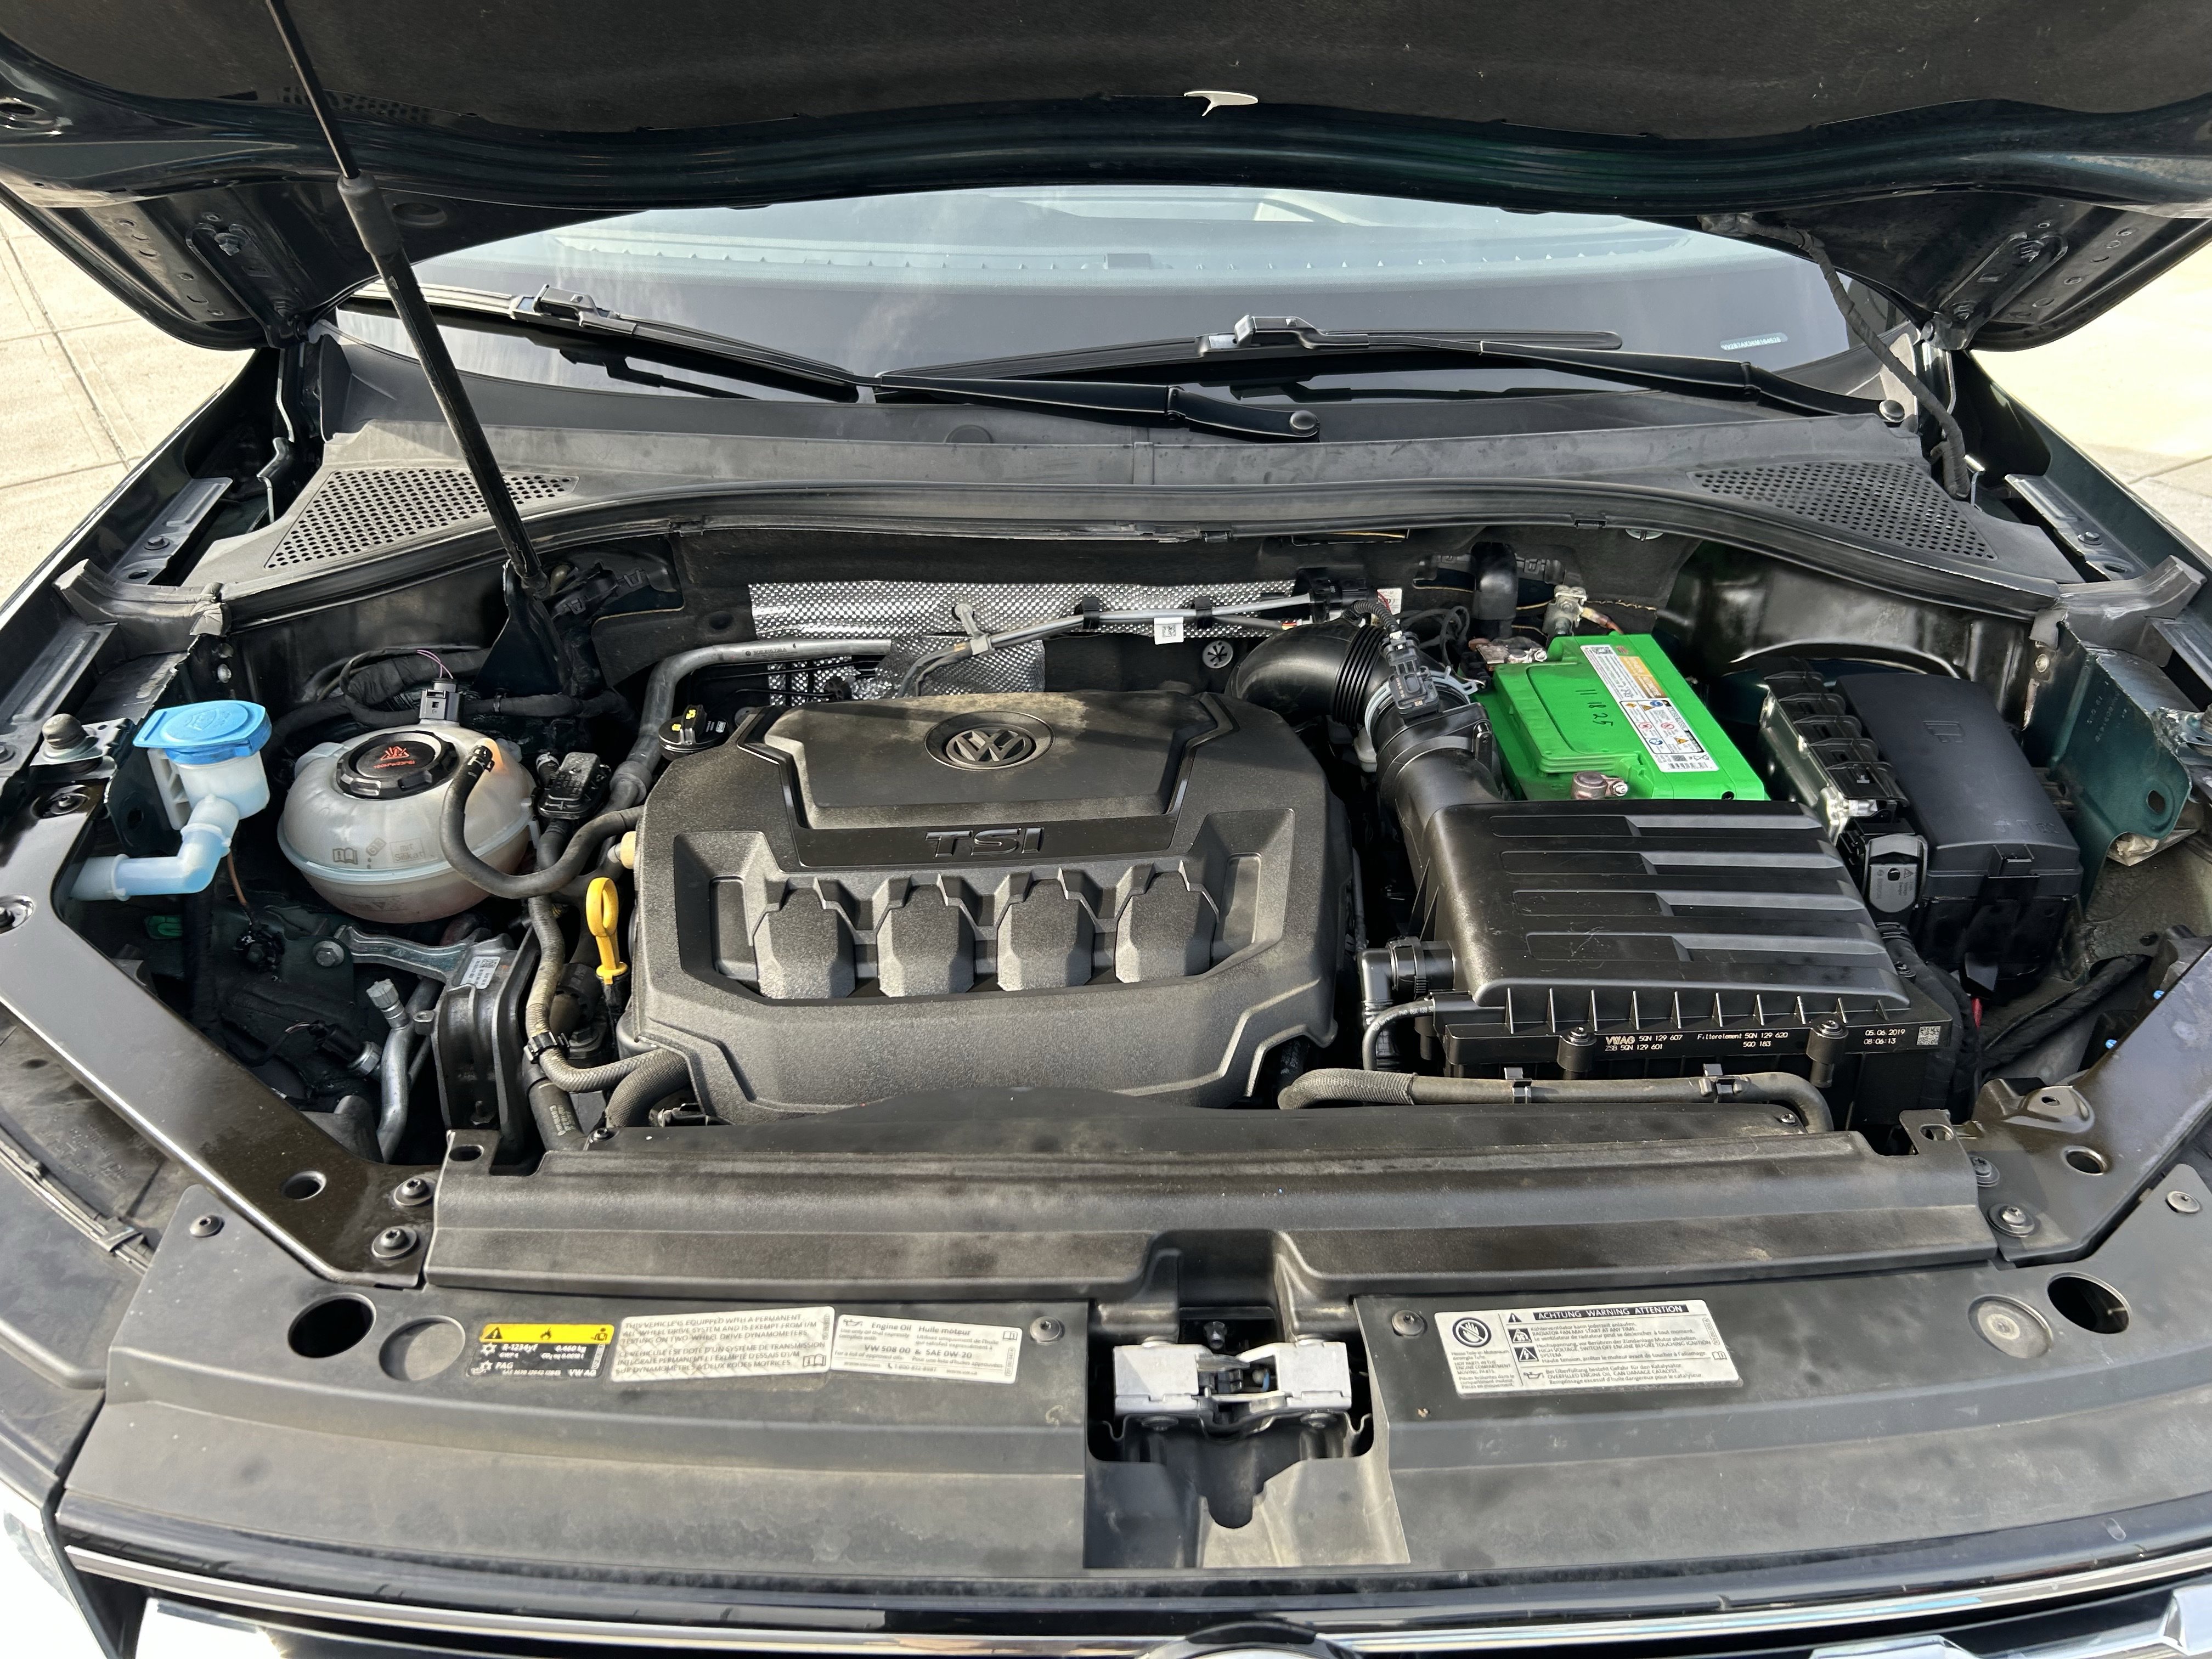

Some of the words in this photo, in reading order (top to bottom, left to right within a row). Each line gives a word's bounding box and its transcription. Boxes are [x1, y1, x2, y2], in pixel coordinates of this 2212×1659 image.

[924, 827, 1044, 857] TSI
[1605, 1036, 1635, 1045] VWAG
[1538, 1311, 1582, 1319] ACHTUNG
[1585, 1308, 1630, 1317] WARNING
[1635, 1305, 1683, 1314] ATTENTION
[686, 1318, 724, 1326] EQUIPPED
[872, 1322, 899, 1331] Engine
[940, 1328, 971, 1336] moteur
[502, 1344, 538, 1355] R-1234yf
[577, 1345, 587, 1354] kg
[771, 1341, 826, 1350] TRANSMISSION
[864, 1344, 881, 1352] VW
[943, 1350, 973, 1359] 0W-20
[495, 1361, 514, 1370] PAG
[753, 1359, 791, 1368] MOTRICES
[568, 1368, 583, 1377] VW
[584, 1368, 597, 1377] AG
